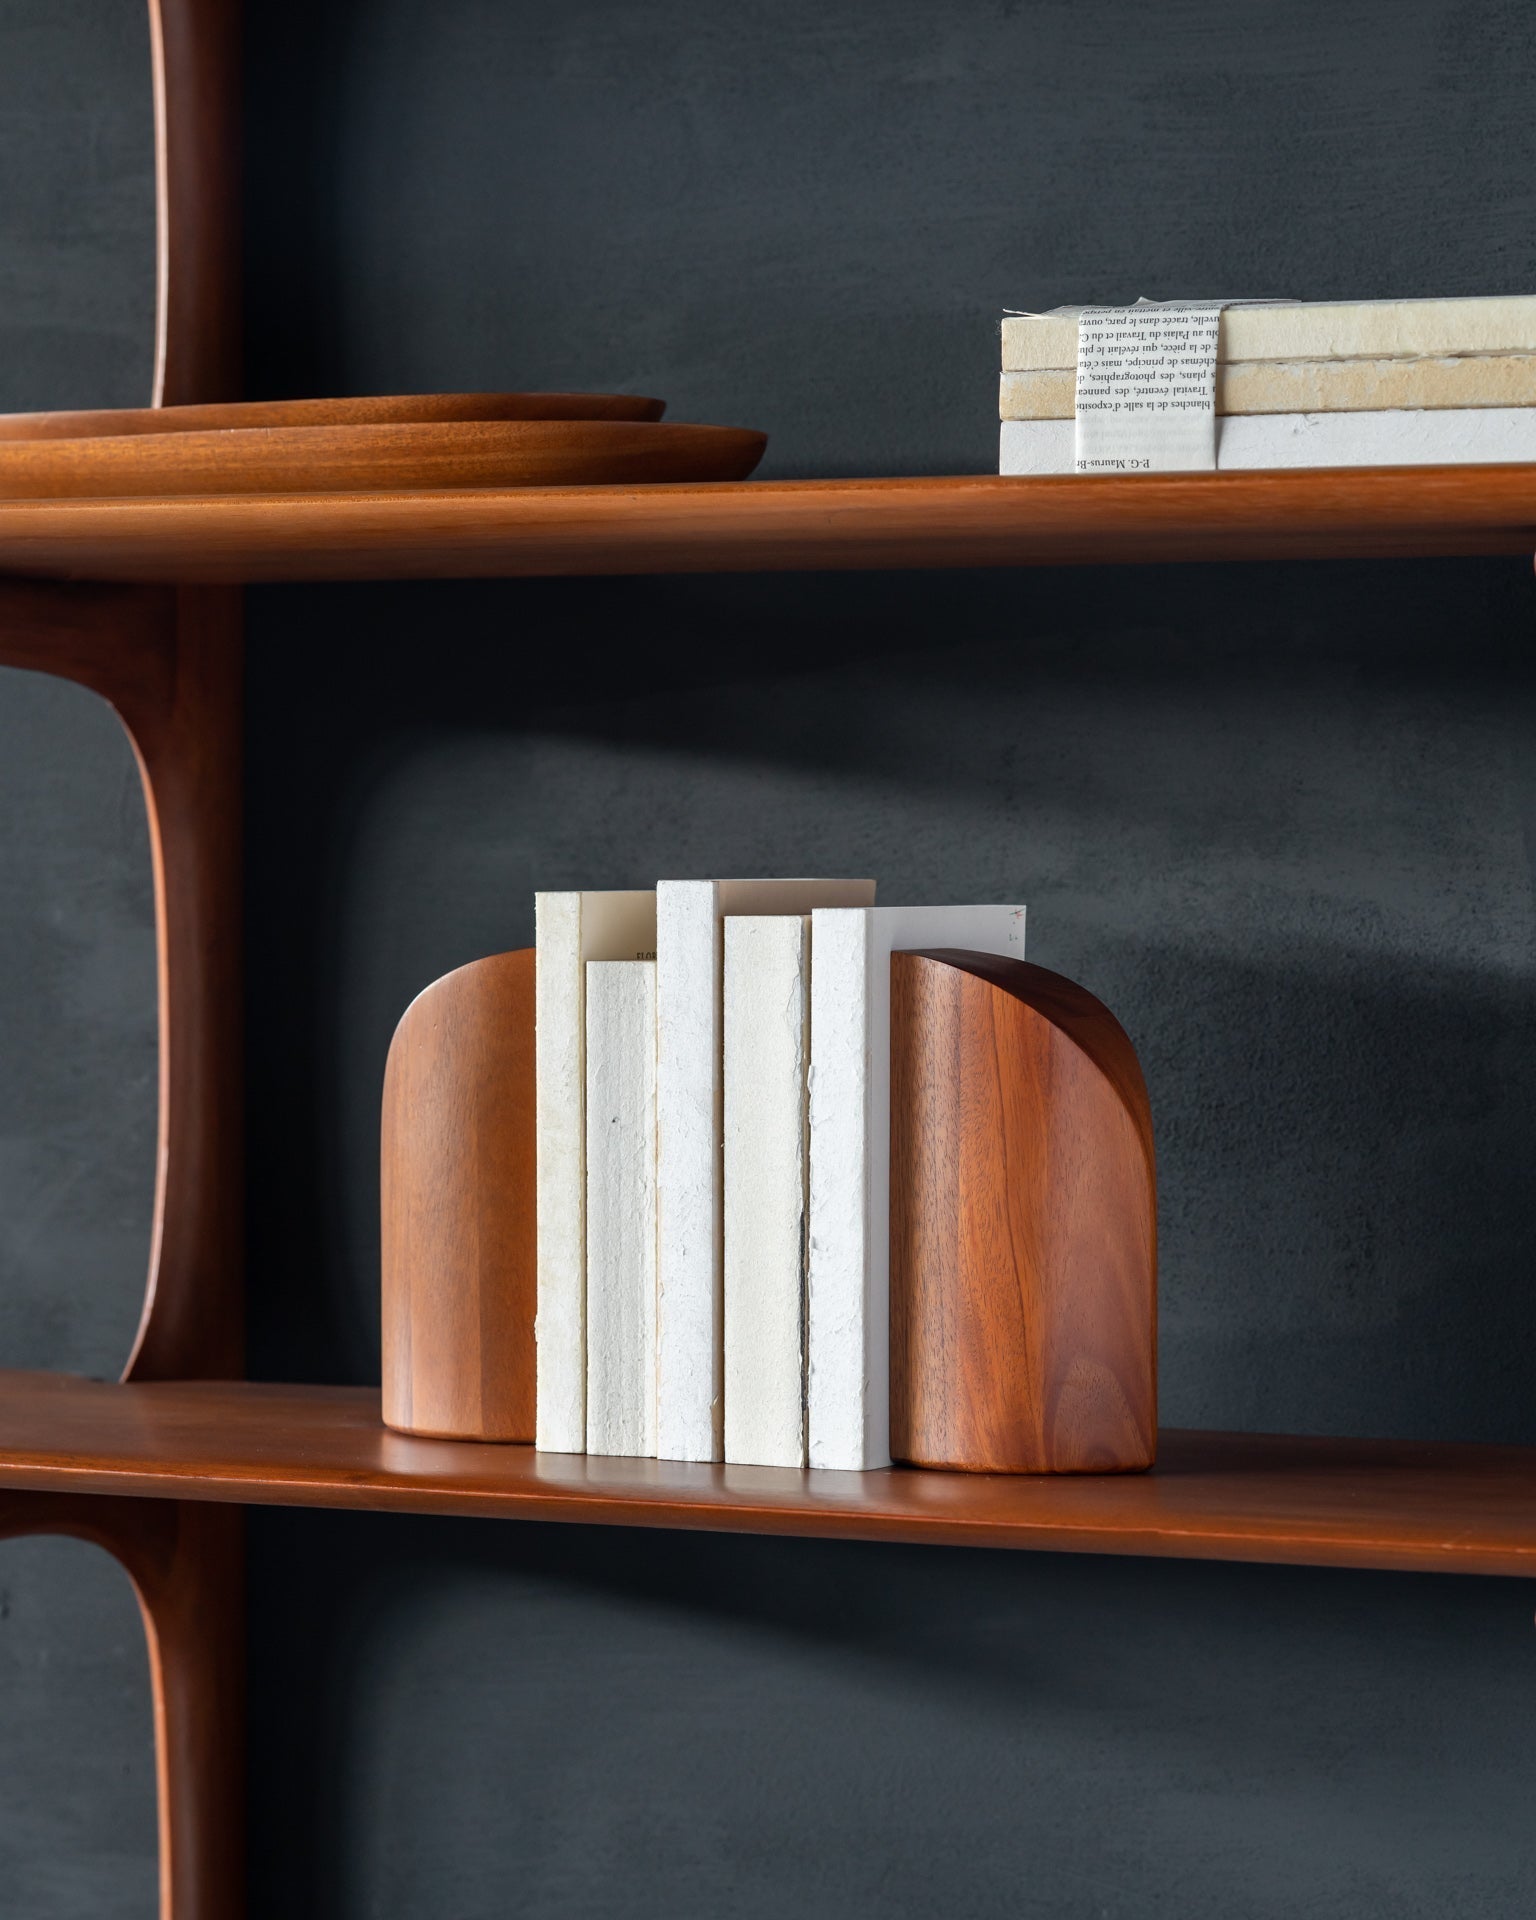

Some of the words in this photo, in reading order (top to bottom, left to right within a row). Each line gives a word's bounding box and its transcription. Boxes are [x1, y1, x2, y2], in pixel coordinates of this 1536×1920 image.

[1105, 316, 1127, 325] parc,
[1129, 318, 1137, 327] le
[1139, 318, 1160, 327] dans
[1162, 317, 1188, 326] tracée
[1092, 333, 1103, 342] du
[1116, 332, 1147, 341] Travail
[1149, 331, 1161, 340] du
[1163, 331, 1189, 340] Palais
[1079, 344, 1094, 356] plu
[1097, 347, 1105, 356] le
[1108, 346, 1139, 356] révélait
[1142, 342, 1158, 355] qui
[1161, 342, 1186, 354] pièce,
[1189, 345, 1197, 353] la
[1200, 344, 1211, 353] de
[1101, 361, 1122, 369] mais
[1126, 356, 1164, 369] principe,
[1167, 359, 1178, 368] de
[1089, 371, 1156, 384] photographies,
[1160, 373, 1175, 382] des
[1179, 369, 1206, 382] plans,
[1078, 386, 1110, 396] pannea
[1115, 388, 1130, 397] des
[1134, 387, 1169, 397] éventré,
[1173, 386, 1208, 397] Travital
[1124, 402, 1143, 412] salle
[1147, 402, 1154, 411] la
[1157, 402, 1168, 411] de
[1171, 401, 1210, 411] blanches
